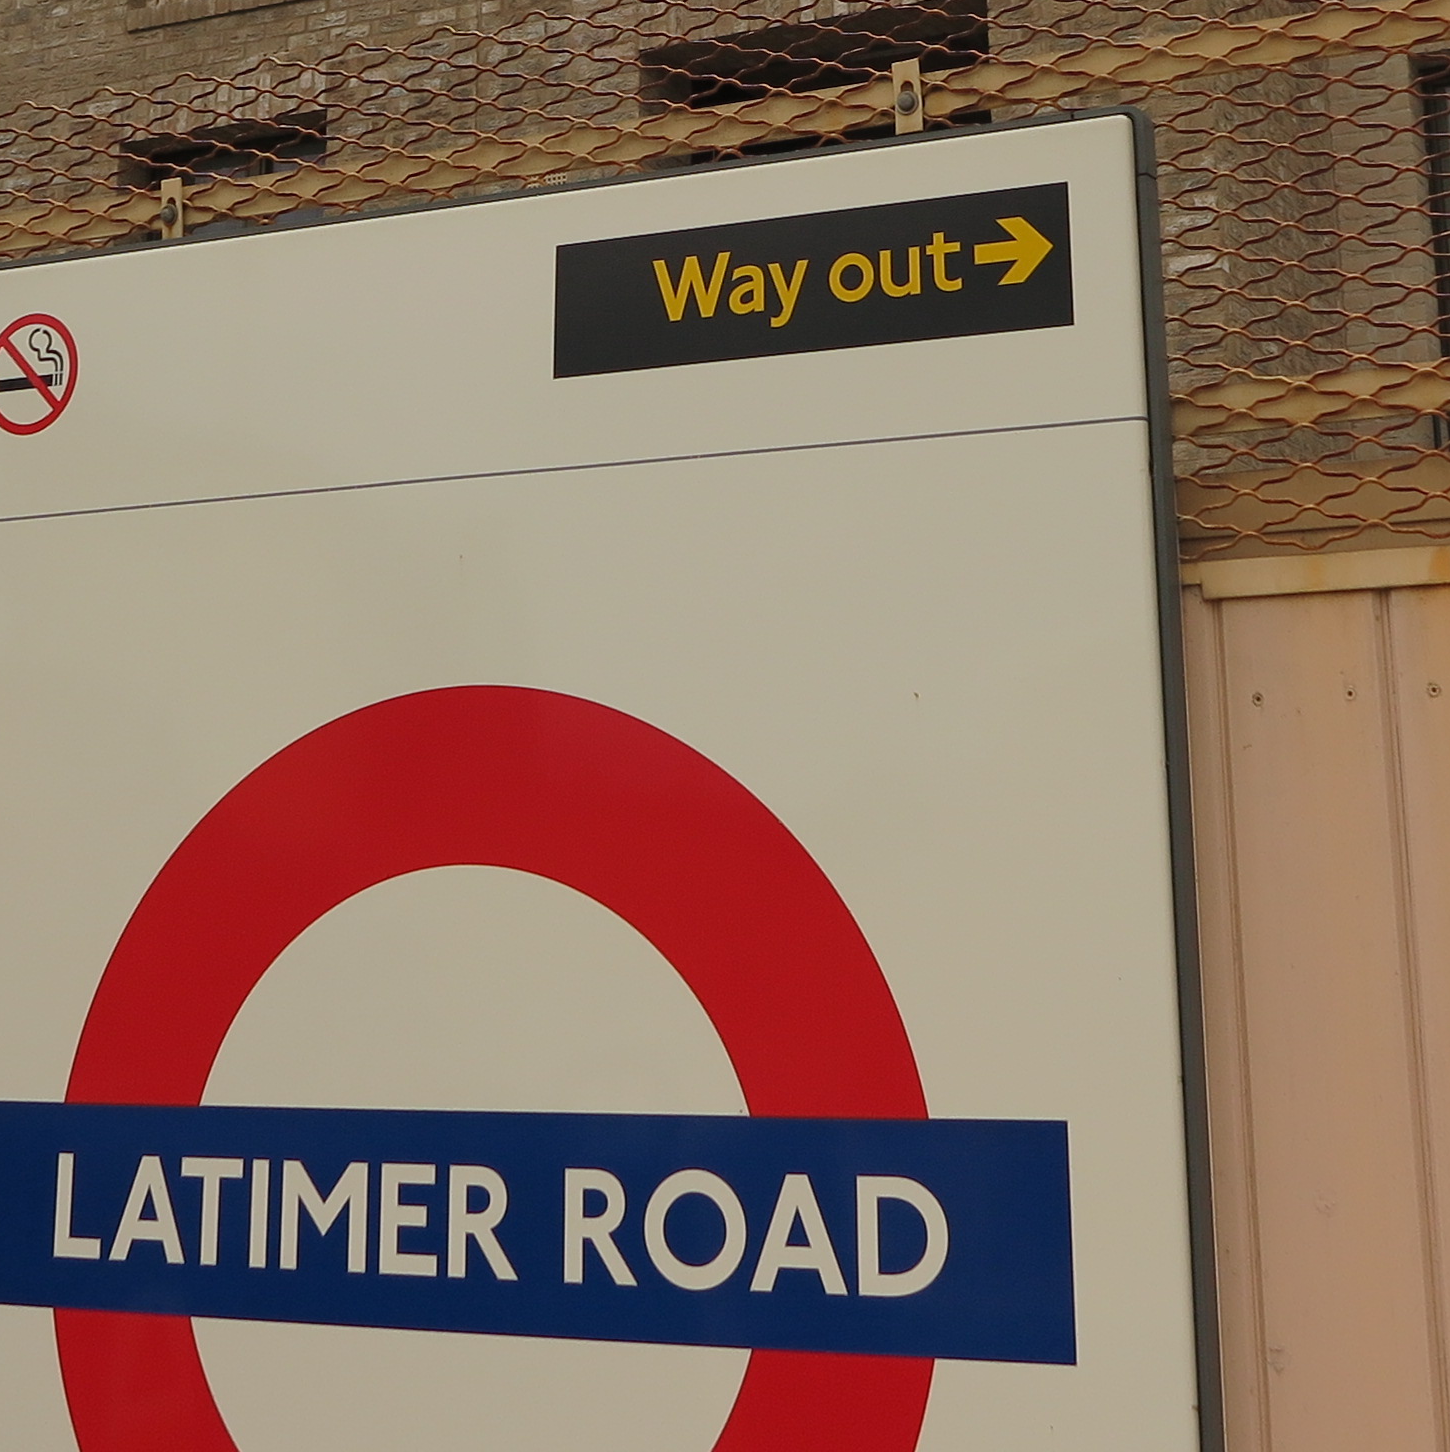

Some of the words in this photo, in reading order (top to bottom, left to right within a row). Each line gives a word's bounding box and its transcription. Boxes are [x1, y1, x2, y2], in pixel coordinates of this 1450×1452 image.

[652, 251, 809, 328] Way
[828, 231, 963, 303] out
[52, 1151, 519, 1281] LATIMER
[563, 1166, 950, 1297] ROAD
